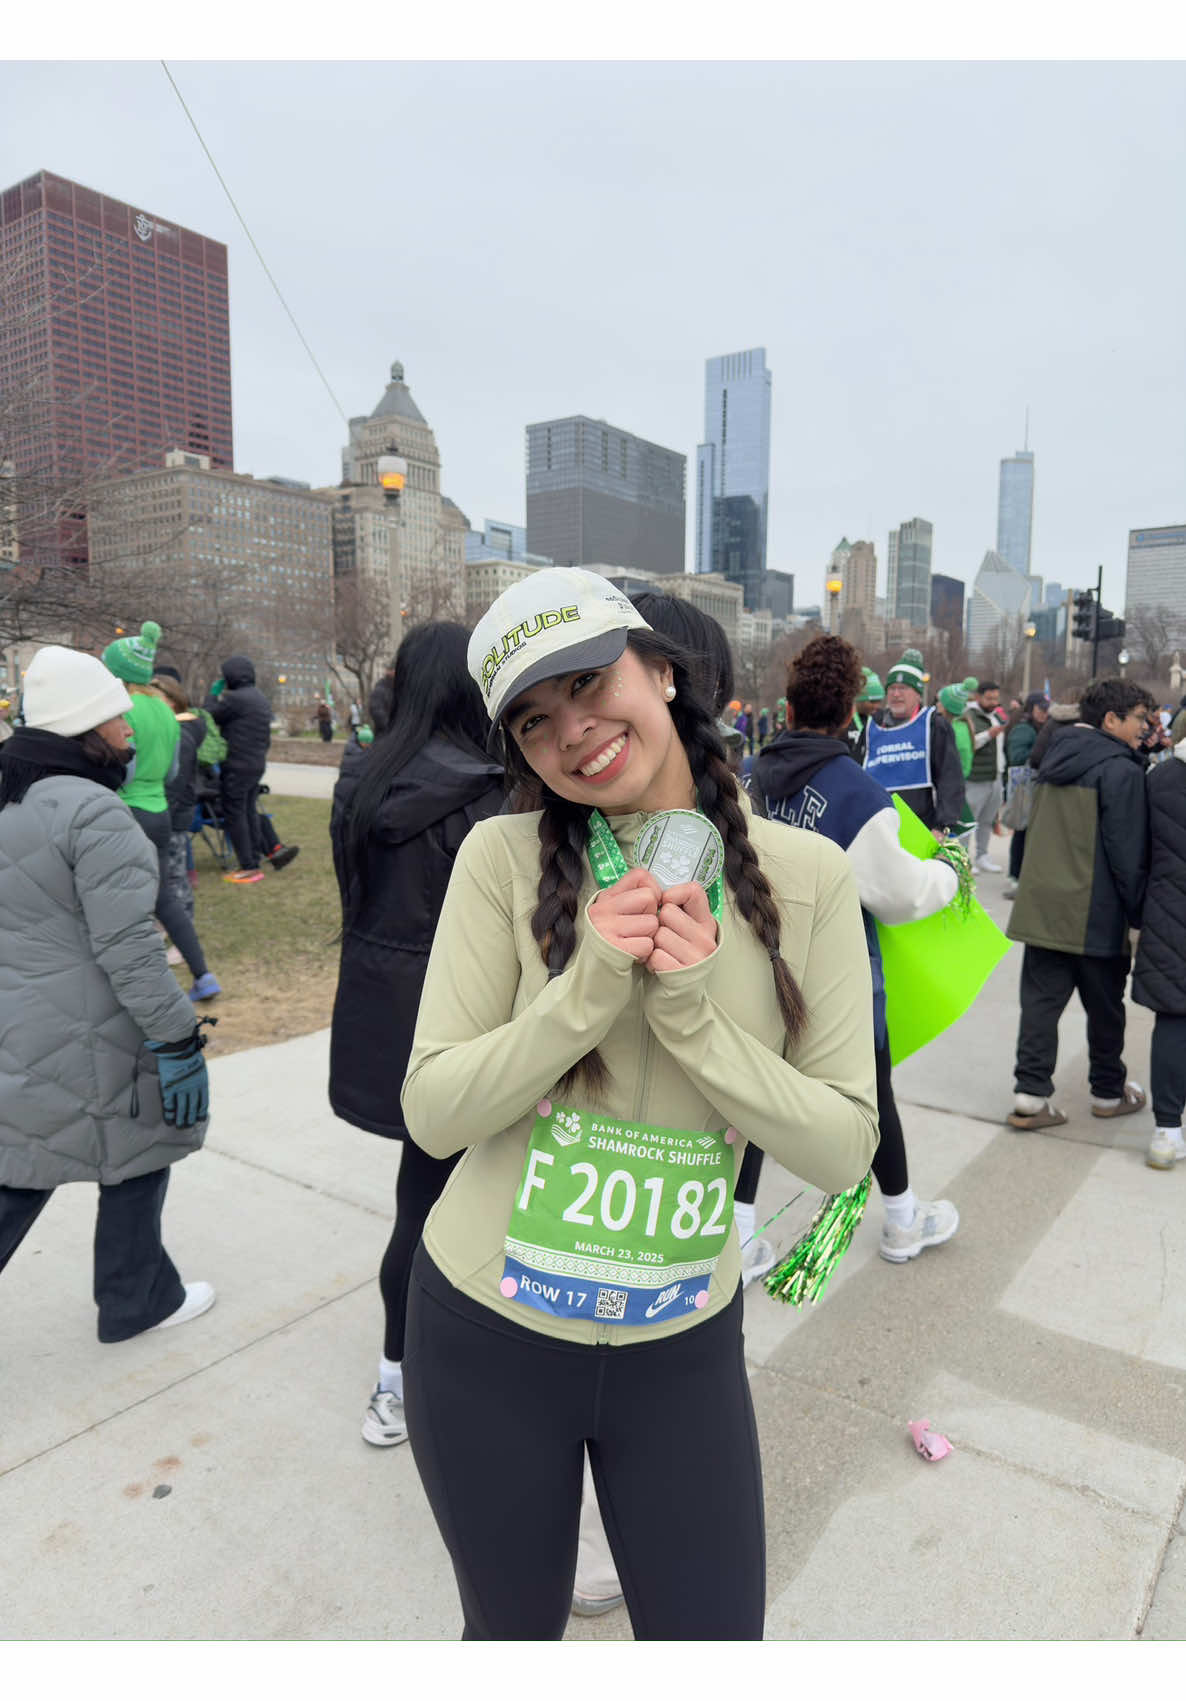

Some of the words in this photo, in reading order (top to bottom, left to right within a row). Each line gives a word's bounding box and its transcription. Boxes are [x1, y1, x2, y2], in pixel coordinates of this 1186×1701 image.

[481, 604, 581, 694] SOLITUDE
[867, 750, 925, 768] PERVISOR
[591, 1123, 623, 1137] BANK
[625, 1129, 641, 1140] OF
[641, 1133, 694, 1149] AMERICA
[587, 1136, 665, 1162] SHAMROCK
[668, 1151, 722, 1166] SHUFFLE
[517, 1148, 555, 1212] F
[561, 1161, 728, 1240] 20182
[574, 1240, 616, 1258] MARCH
[617, 1247, 634, 1262] 23,
[637, 1250, 665, 1264] 2025
[520, 1274, 561, 1302] ROW
[565, 1289, 588, 1308] 17
[655, 1283, 682, 1305] RUN
